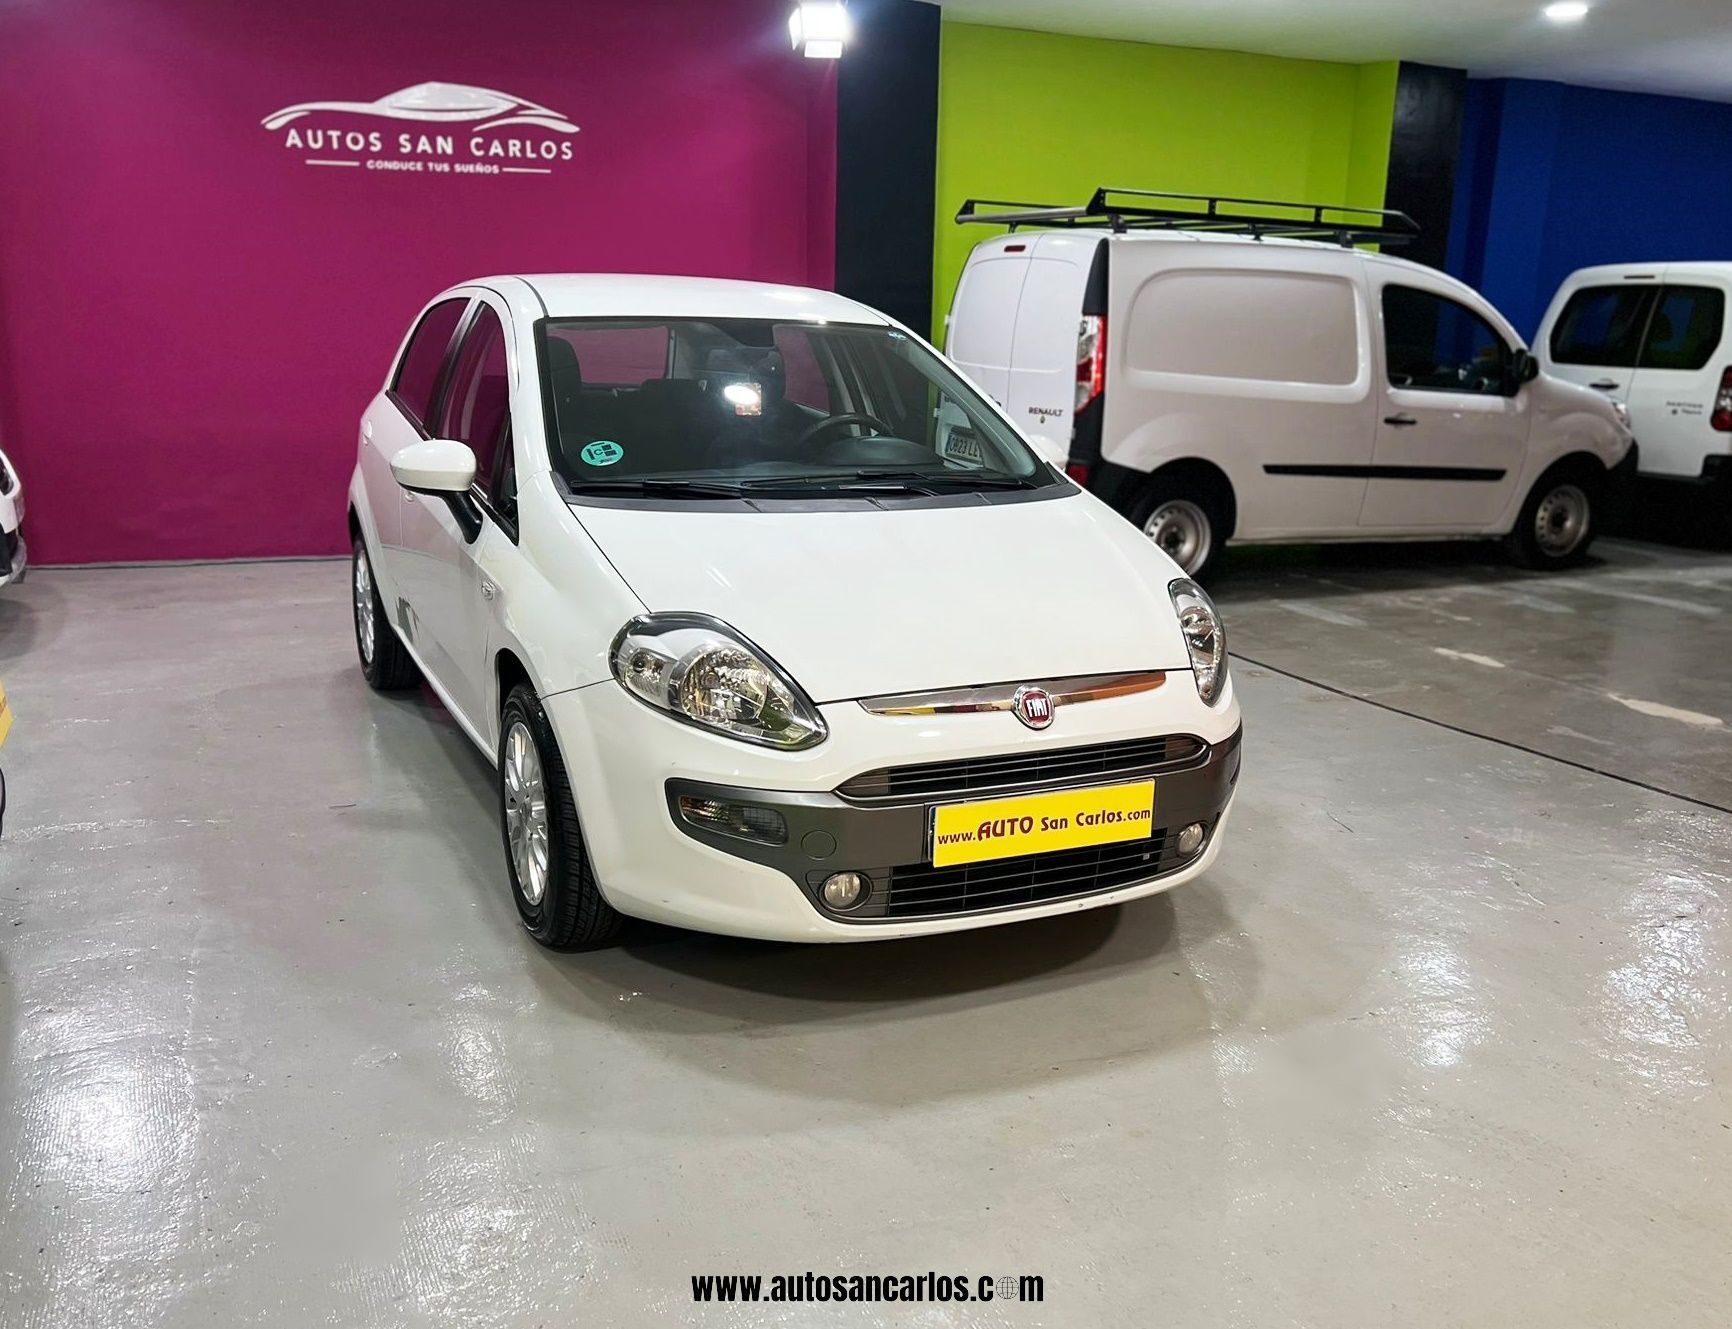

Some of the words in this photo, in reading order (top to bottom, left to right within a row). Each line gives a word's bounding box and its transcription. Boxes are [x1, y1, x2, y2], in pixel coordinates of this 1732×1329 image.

[286, 128, 382, 152] AUTOS
[399, 133, 453, 155] SAN
[470, 137, 573, 160] CARLOS
[366, 160, 423, 172] CONDUCE
[427, 162, 449, 173] TUS
[454, 162, 499, 174] SUEÑOS
[1028, 406, 1063, 416] RENAULT
[1025, 698, 1048, 717] FIAT
[938, 816, 1034, 845] www.AUTO
[1040, 817, 1068, 832] San
[1076, 809, 1151, 827] Carlos.com
